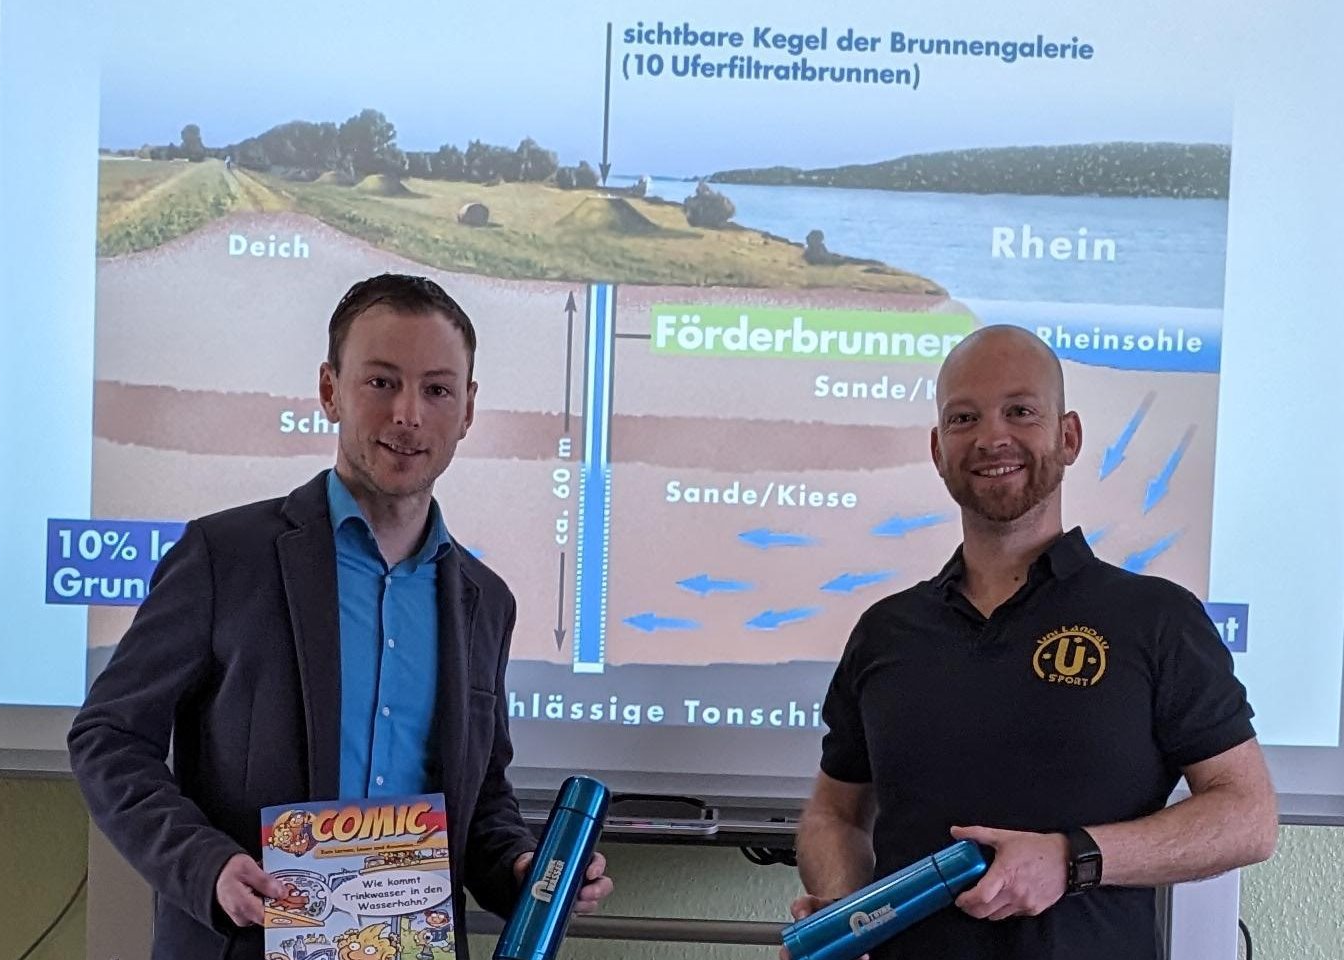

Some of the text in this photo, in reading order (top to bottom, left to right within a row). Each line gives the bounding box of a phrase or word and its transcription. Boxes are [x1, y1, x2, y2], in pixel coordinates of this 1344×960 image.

[623, 24, 1095, 62] sichtbare Kegel der Brunnengalerie
[622, 52, 921, 90] (10 Uferfiltratbrunnen)
[229, 235, 309, 259] Deich
[992, 226, 1116, 262] Rhein
[553, 437, 571, 545] ca. 60 m
[666, 481, 857, 510] Sande/Kiese
[59, 529, 137, 561] 10%
[1048, 673, 1089, 687] SPORT
[312, 803, 432, 842] COMIC
[343, 886, 443, 901] Trinkwasser in den
[362, 876, 421, 889] Wie kommt
[358, 897, 428, 911] Wasserhahn?
